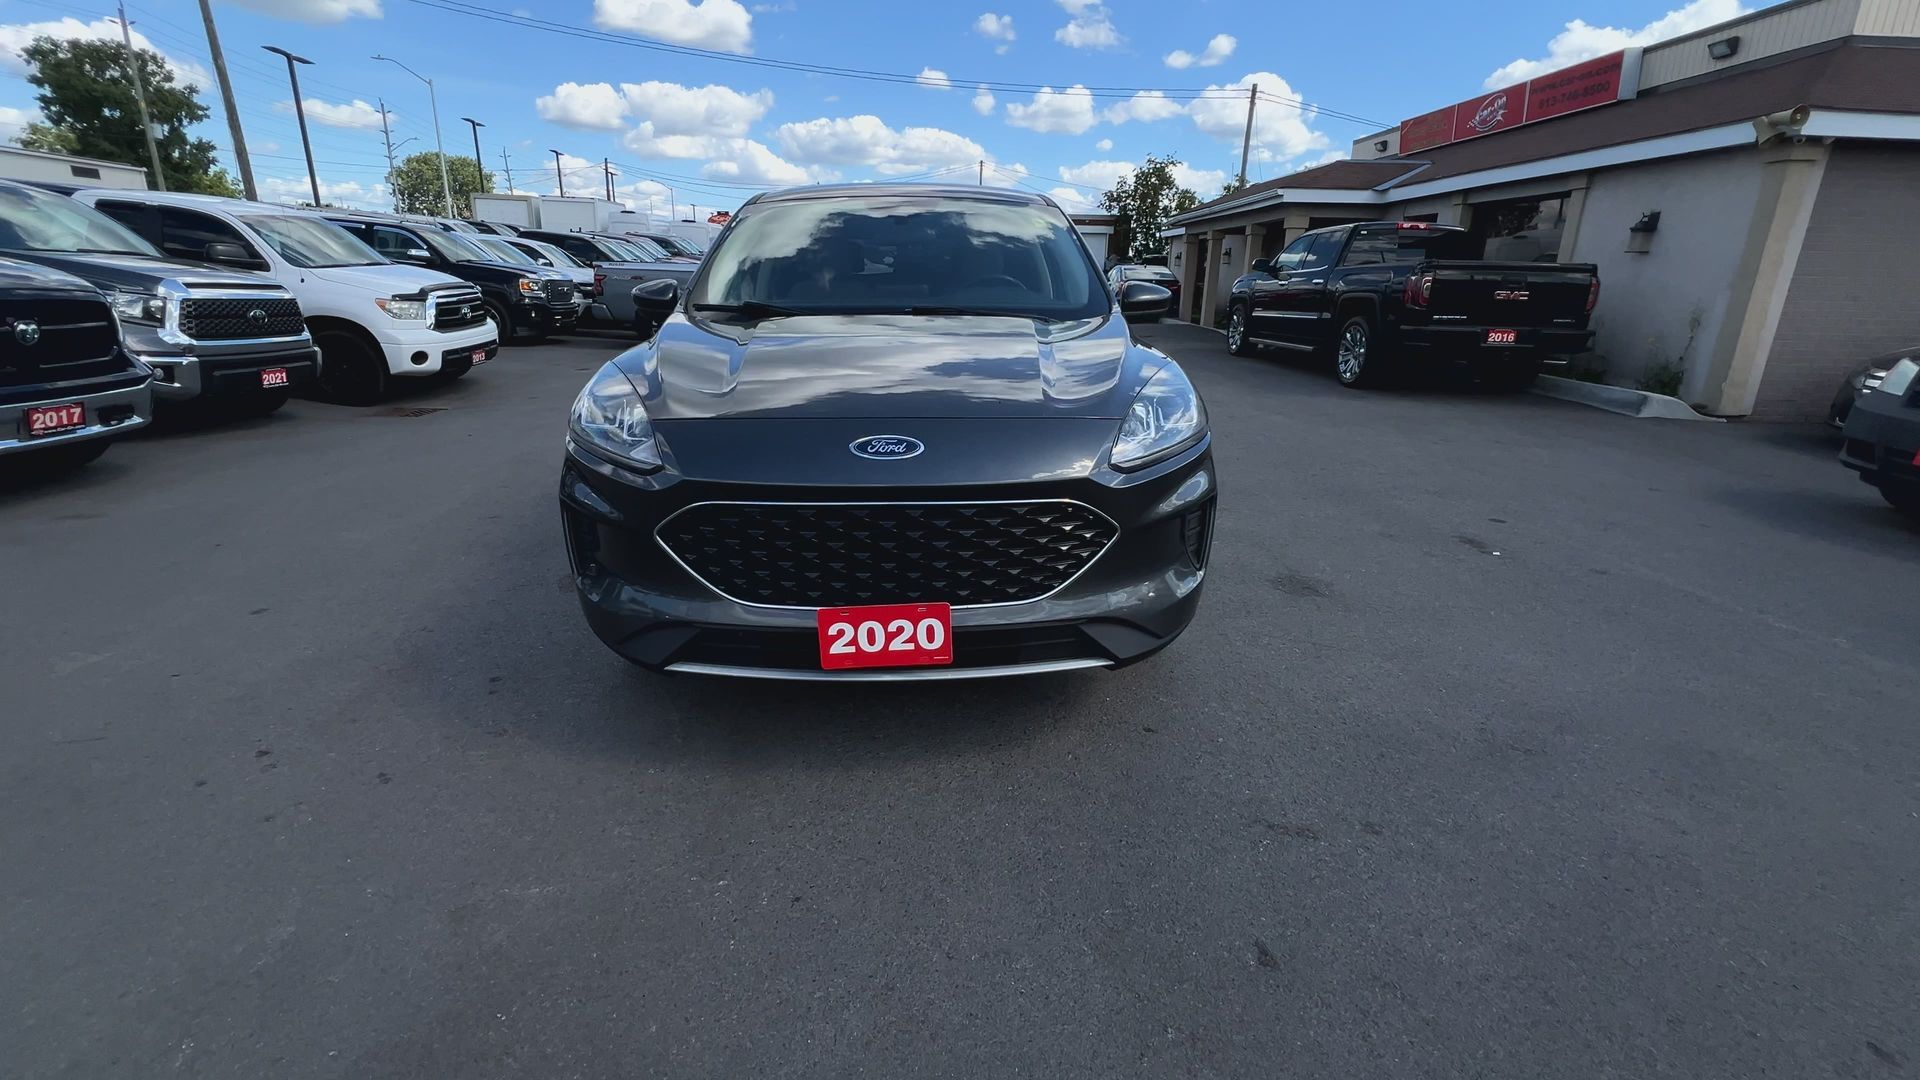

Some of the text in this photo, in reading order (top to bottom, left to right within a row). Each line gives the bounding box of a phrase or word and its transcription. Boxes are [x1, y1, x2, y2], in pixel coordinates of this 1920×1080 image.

[1494, 290, 1530, 301] GMC
[1487, 332, 1515, 342] 2016
[262, 371, 288, 385] 2021
[32, 407, 82, 429] 2017
[867, 439, 907, 453] Ford
[827, 617, 945, 655] 2020
